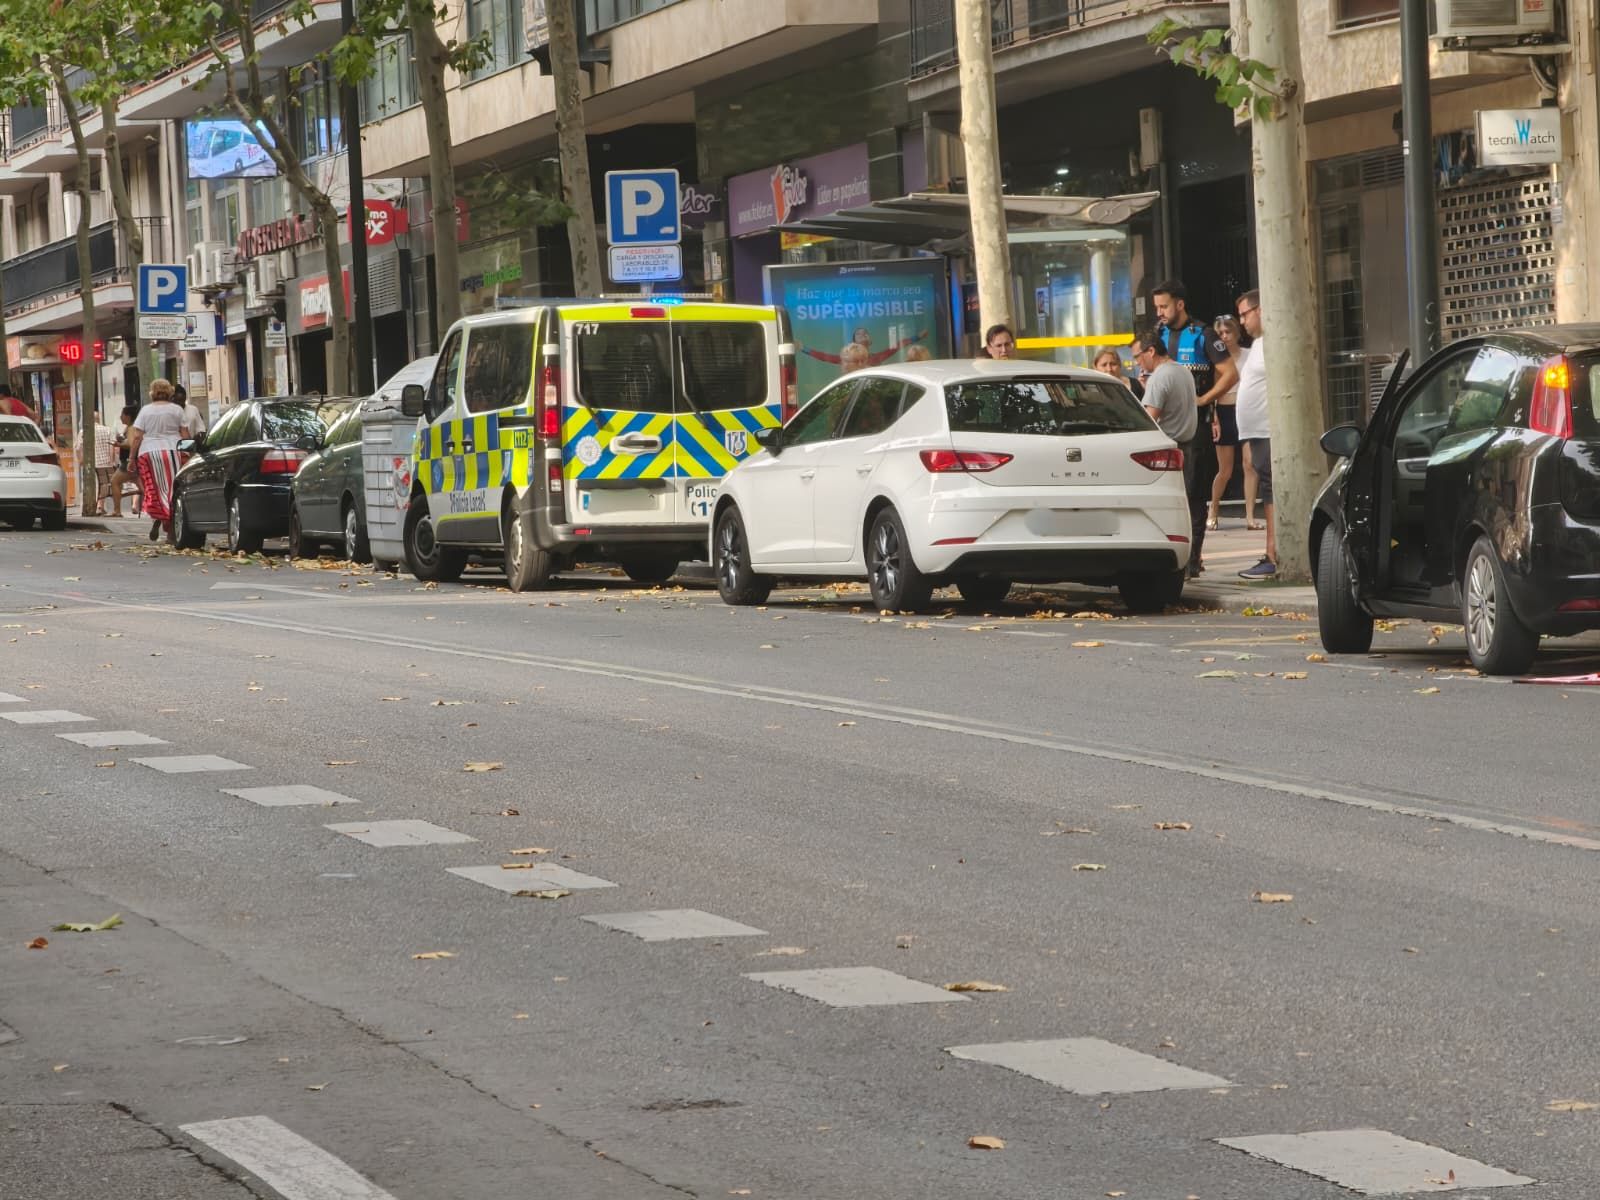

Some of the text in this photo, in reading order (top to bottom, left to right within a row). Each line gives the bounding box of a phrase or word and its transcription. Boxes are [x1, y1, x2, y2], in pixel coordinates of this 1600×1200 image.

[1488, 119, 1556, 145] tecniWatch
[621, 179, 664, 236] P
[148, 269, 178, 307] P
[797, 287, 821, 299] Haz
[824, 288, 844, 301] que
[863, 287, 900, 297] marca
[903, 286, 920, 295] sea
[575, 323, 599, 335] 717
[60, 344, 80, 359] 40
[687, 485, 718, 498] Polic
